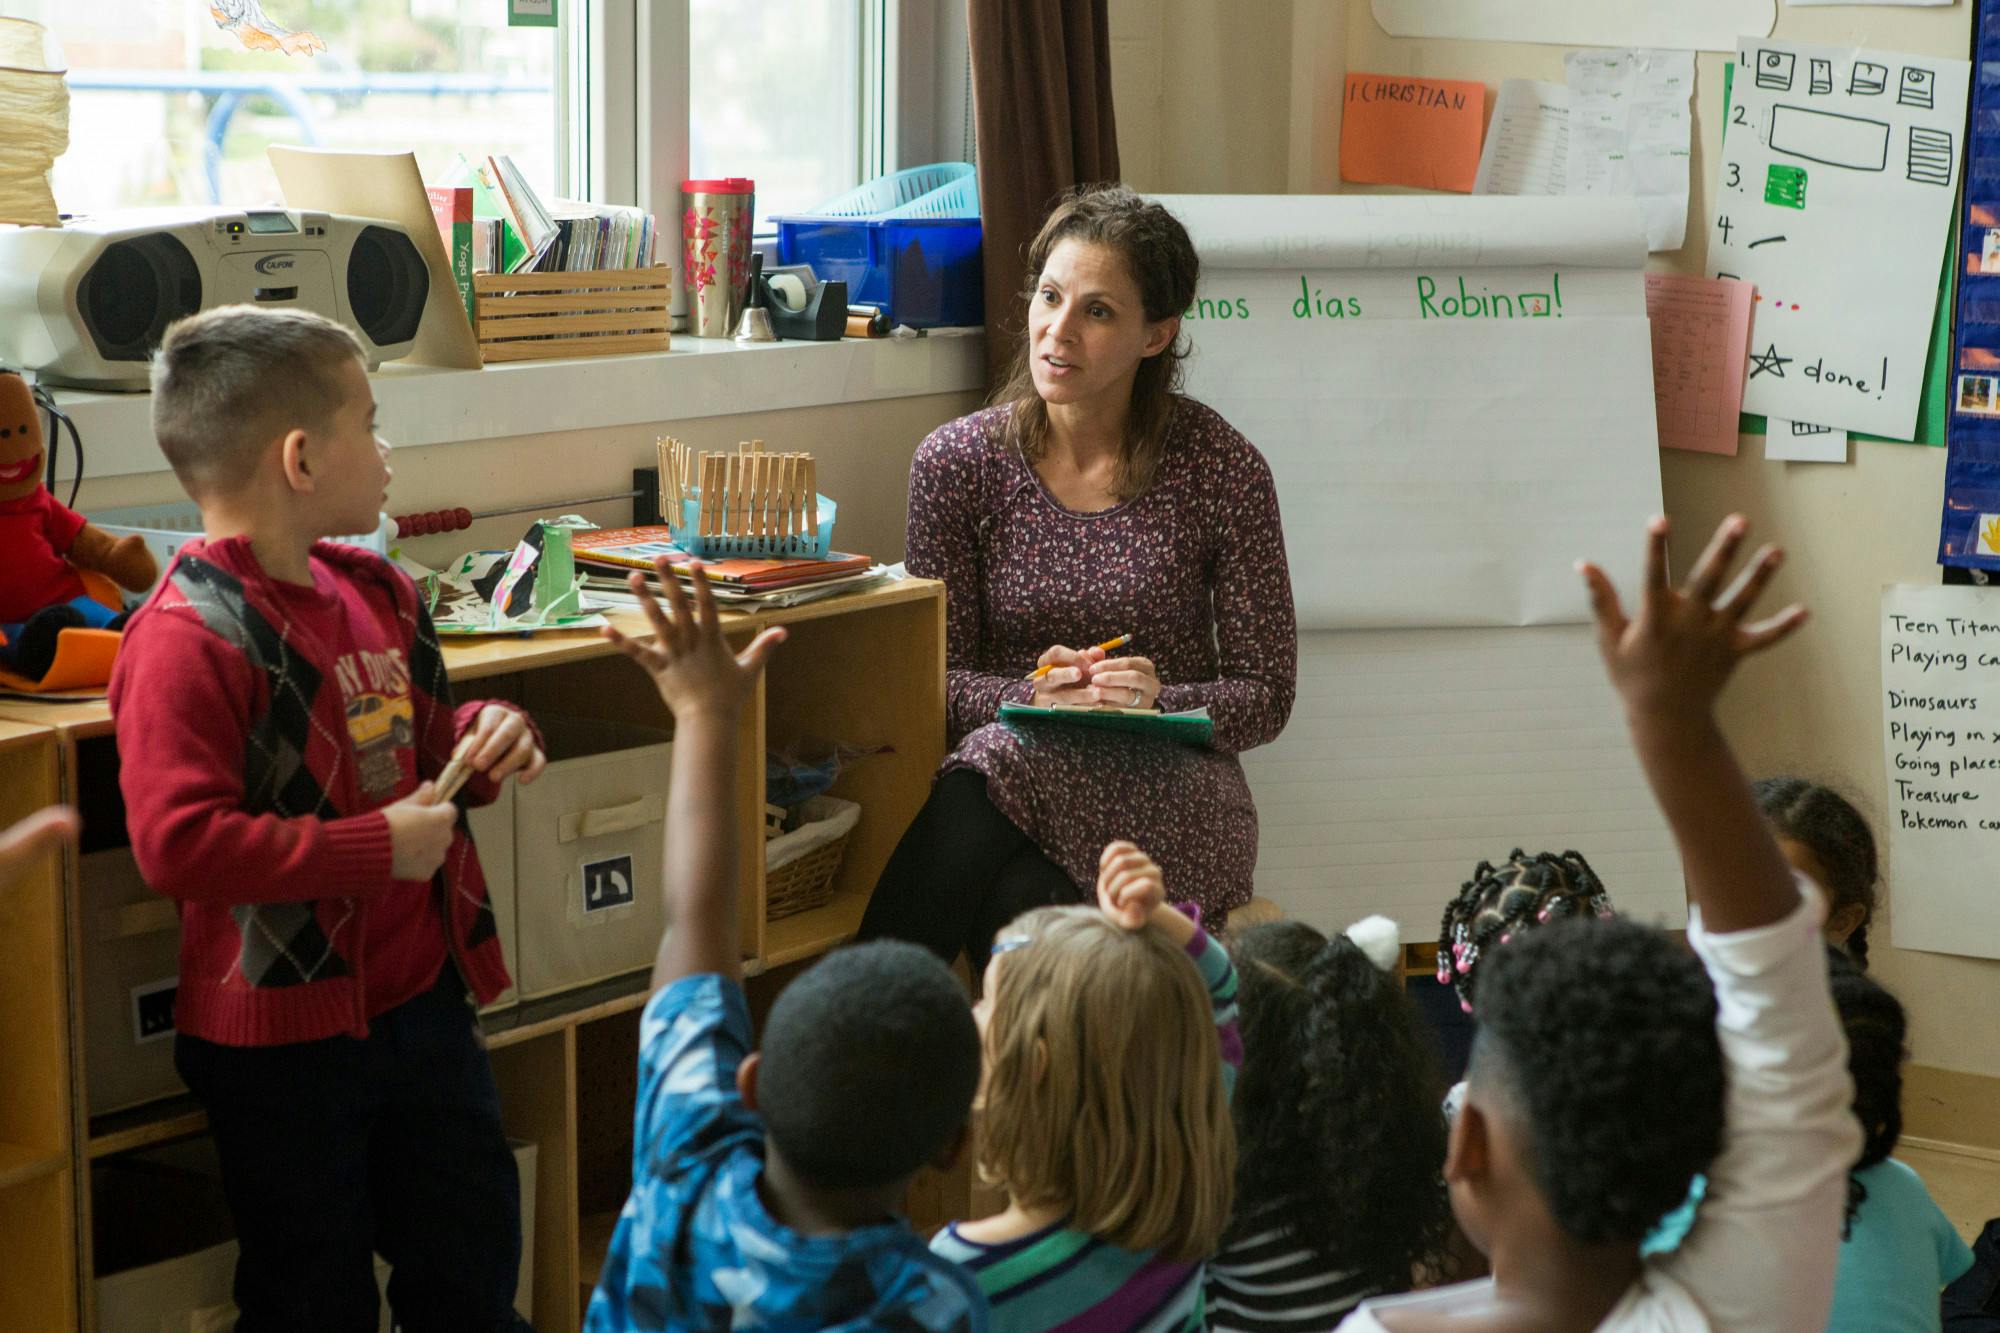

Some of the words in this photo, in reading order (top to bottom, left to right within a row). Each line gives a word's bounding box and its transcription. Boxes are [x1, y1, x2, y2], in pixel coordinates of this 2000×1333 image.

[1726, 163, 1744, 193] 3.
[1717, 215, 1734, 247] 4.
[459, 242, 470, 276] Yoga
[1183, 297, 1250, 320] enos
[1292, 274, 1361, 319] días
[1804, 356, 1888, 401] done!
[1889, 615, 1939, 635] Teen
[1891, 643, 1968, 673] Playing
[1887, 689, 1977, 711] Dinosaurs
[1890, 721, 1956, 752] Playing
[1967, 731, 1985, 741] on
[1895, 752, 1940, 777] Going
[1894, 778, 1979, 804] Treasure
[1900, 809, 1968, 830] Pokemon
